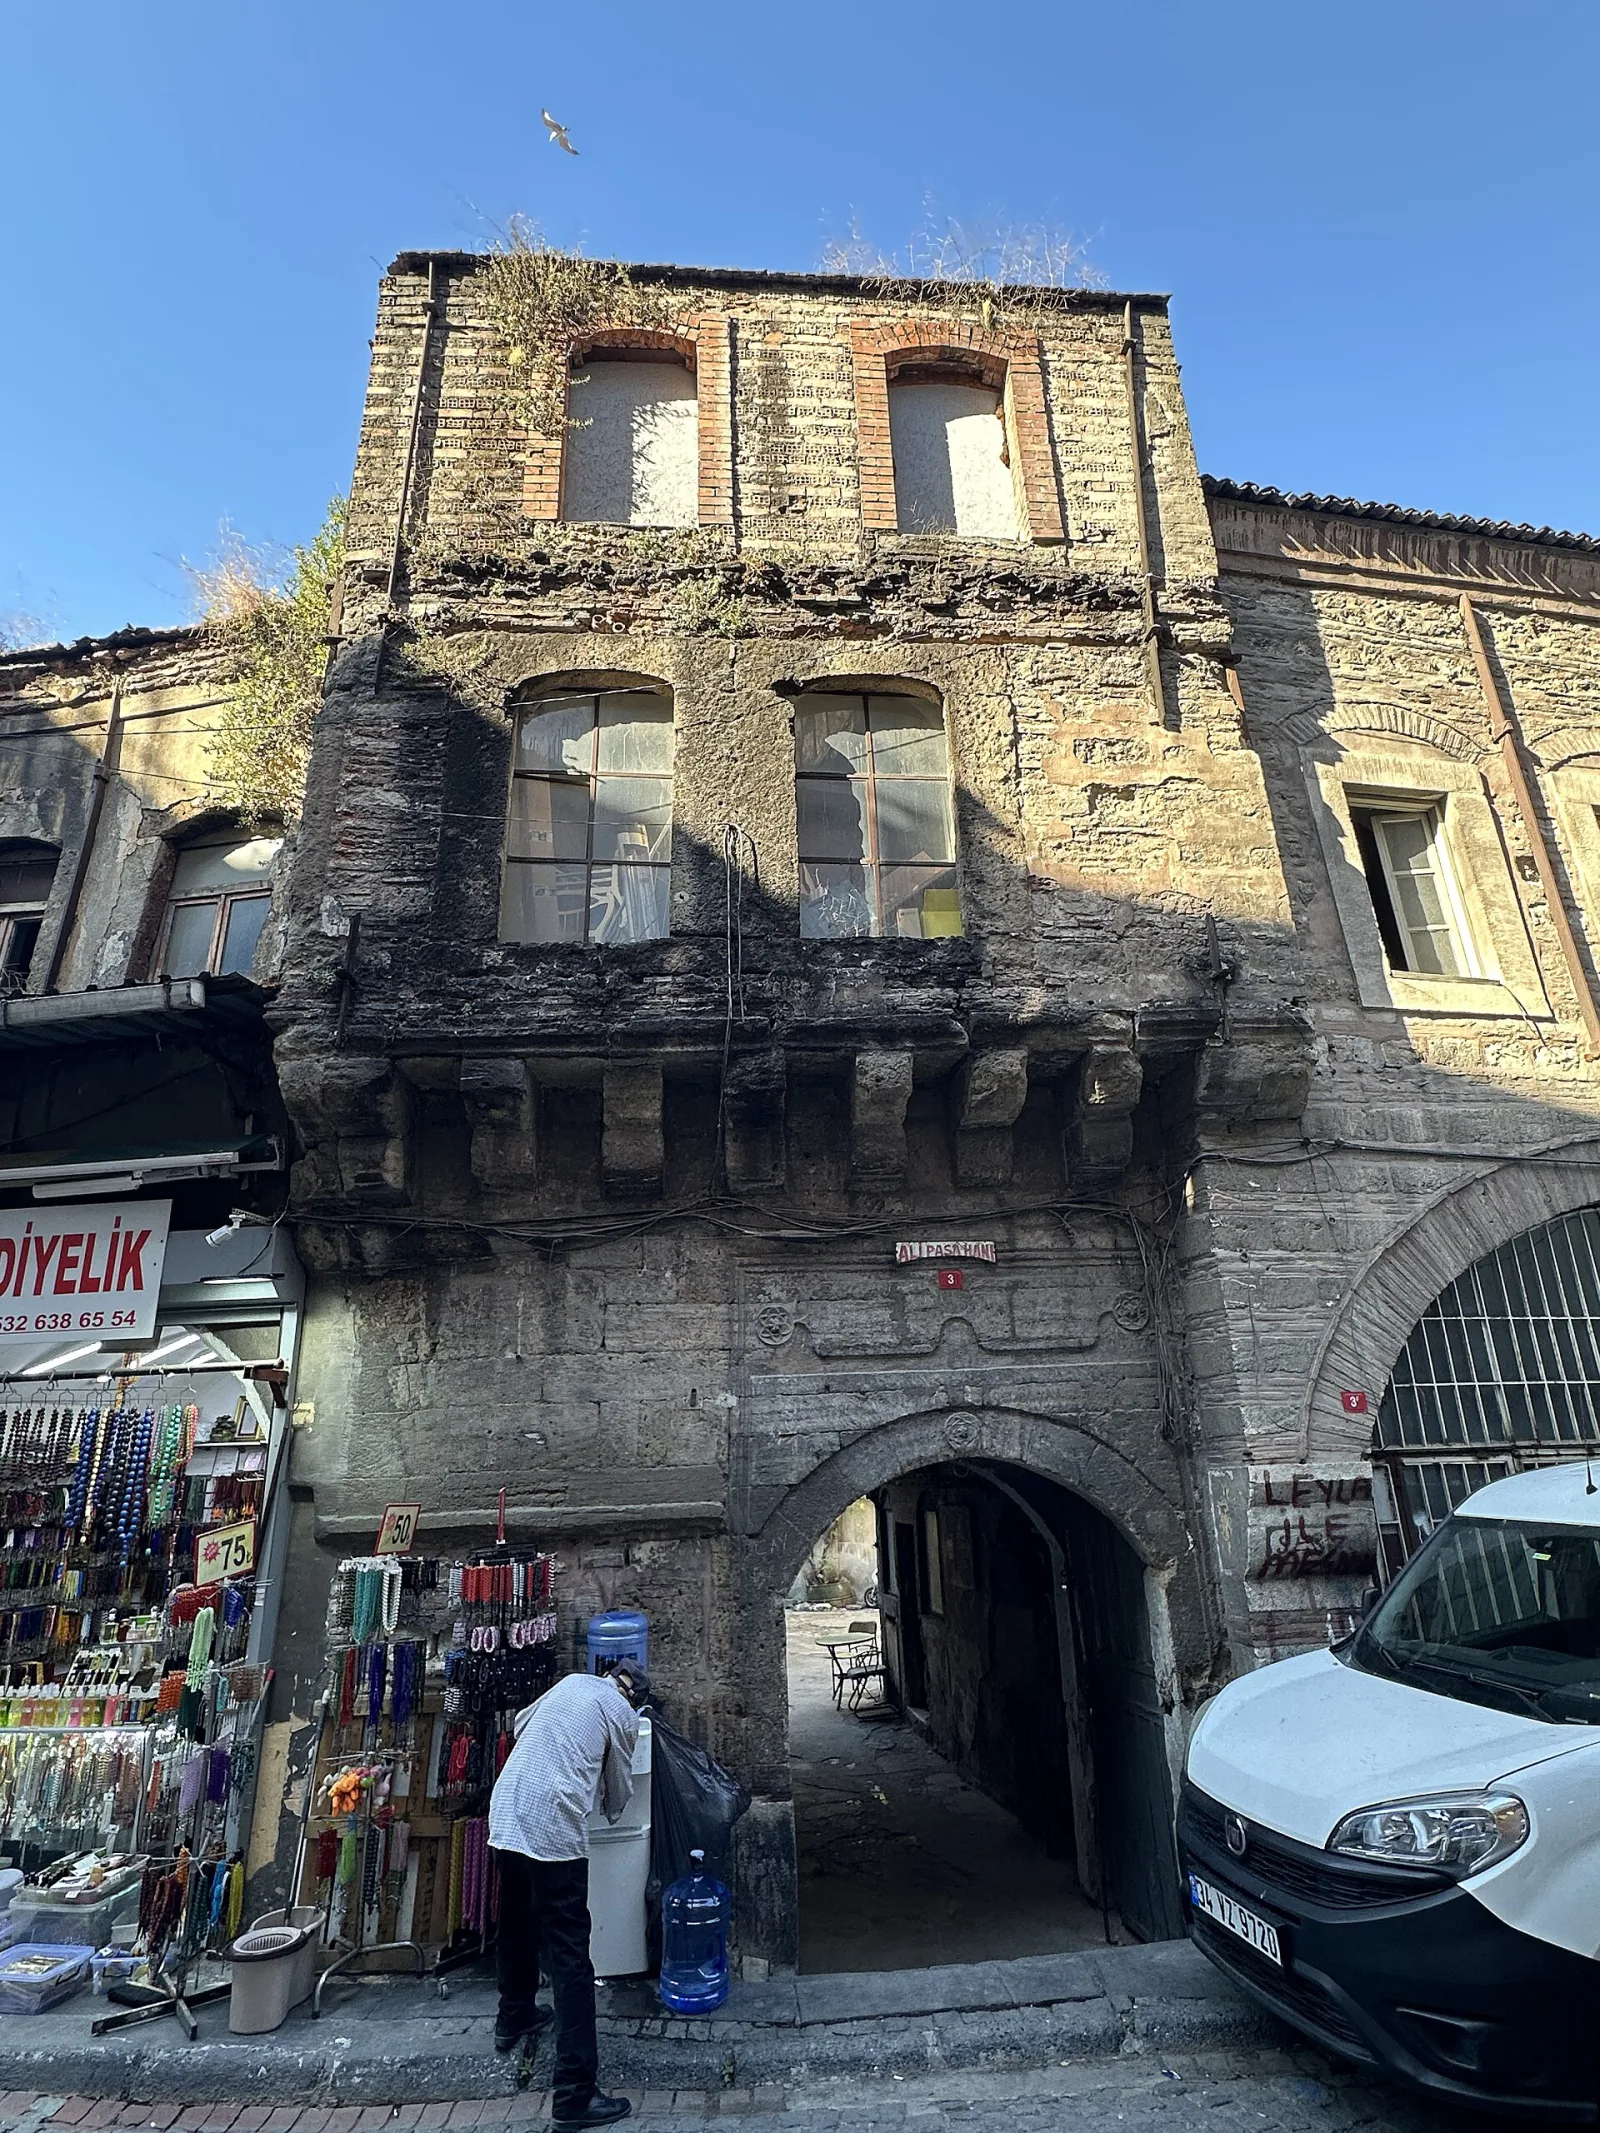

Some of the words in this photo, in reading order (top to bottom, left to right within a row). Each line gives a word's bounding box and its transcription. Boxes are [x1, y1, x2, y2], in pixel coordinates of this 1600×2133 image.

[947, 1274, 955, 1285] 3
[0, 1315, 28, 1331] 32
[35, 1313, 72, 1330] 638
[79, 1311, 105, 1328] 65
[111, 1309, 136, 1327] 54
[1196, 1880, 1213, 1913] 34
[1217, 1892, 1237, 1930] YZ
[1238, 1909, 1278, 1959] 9720
